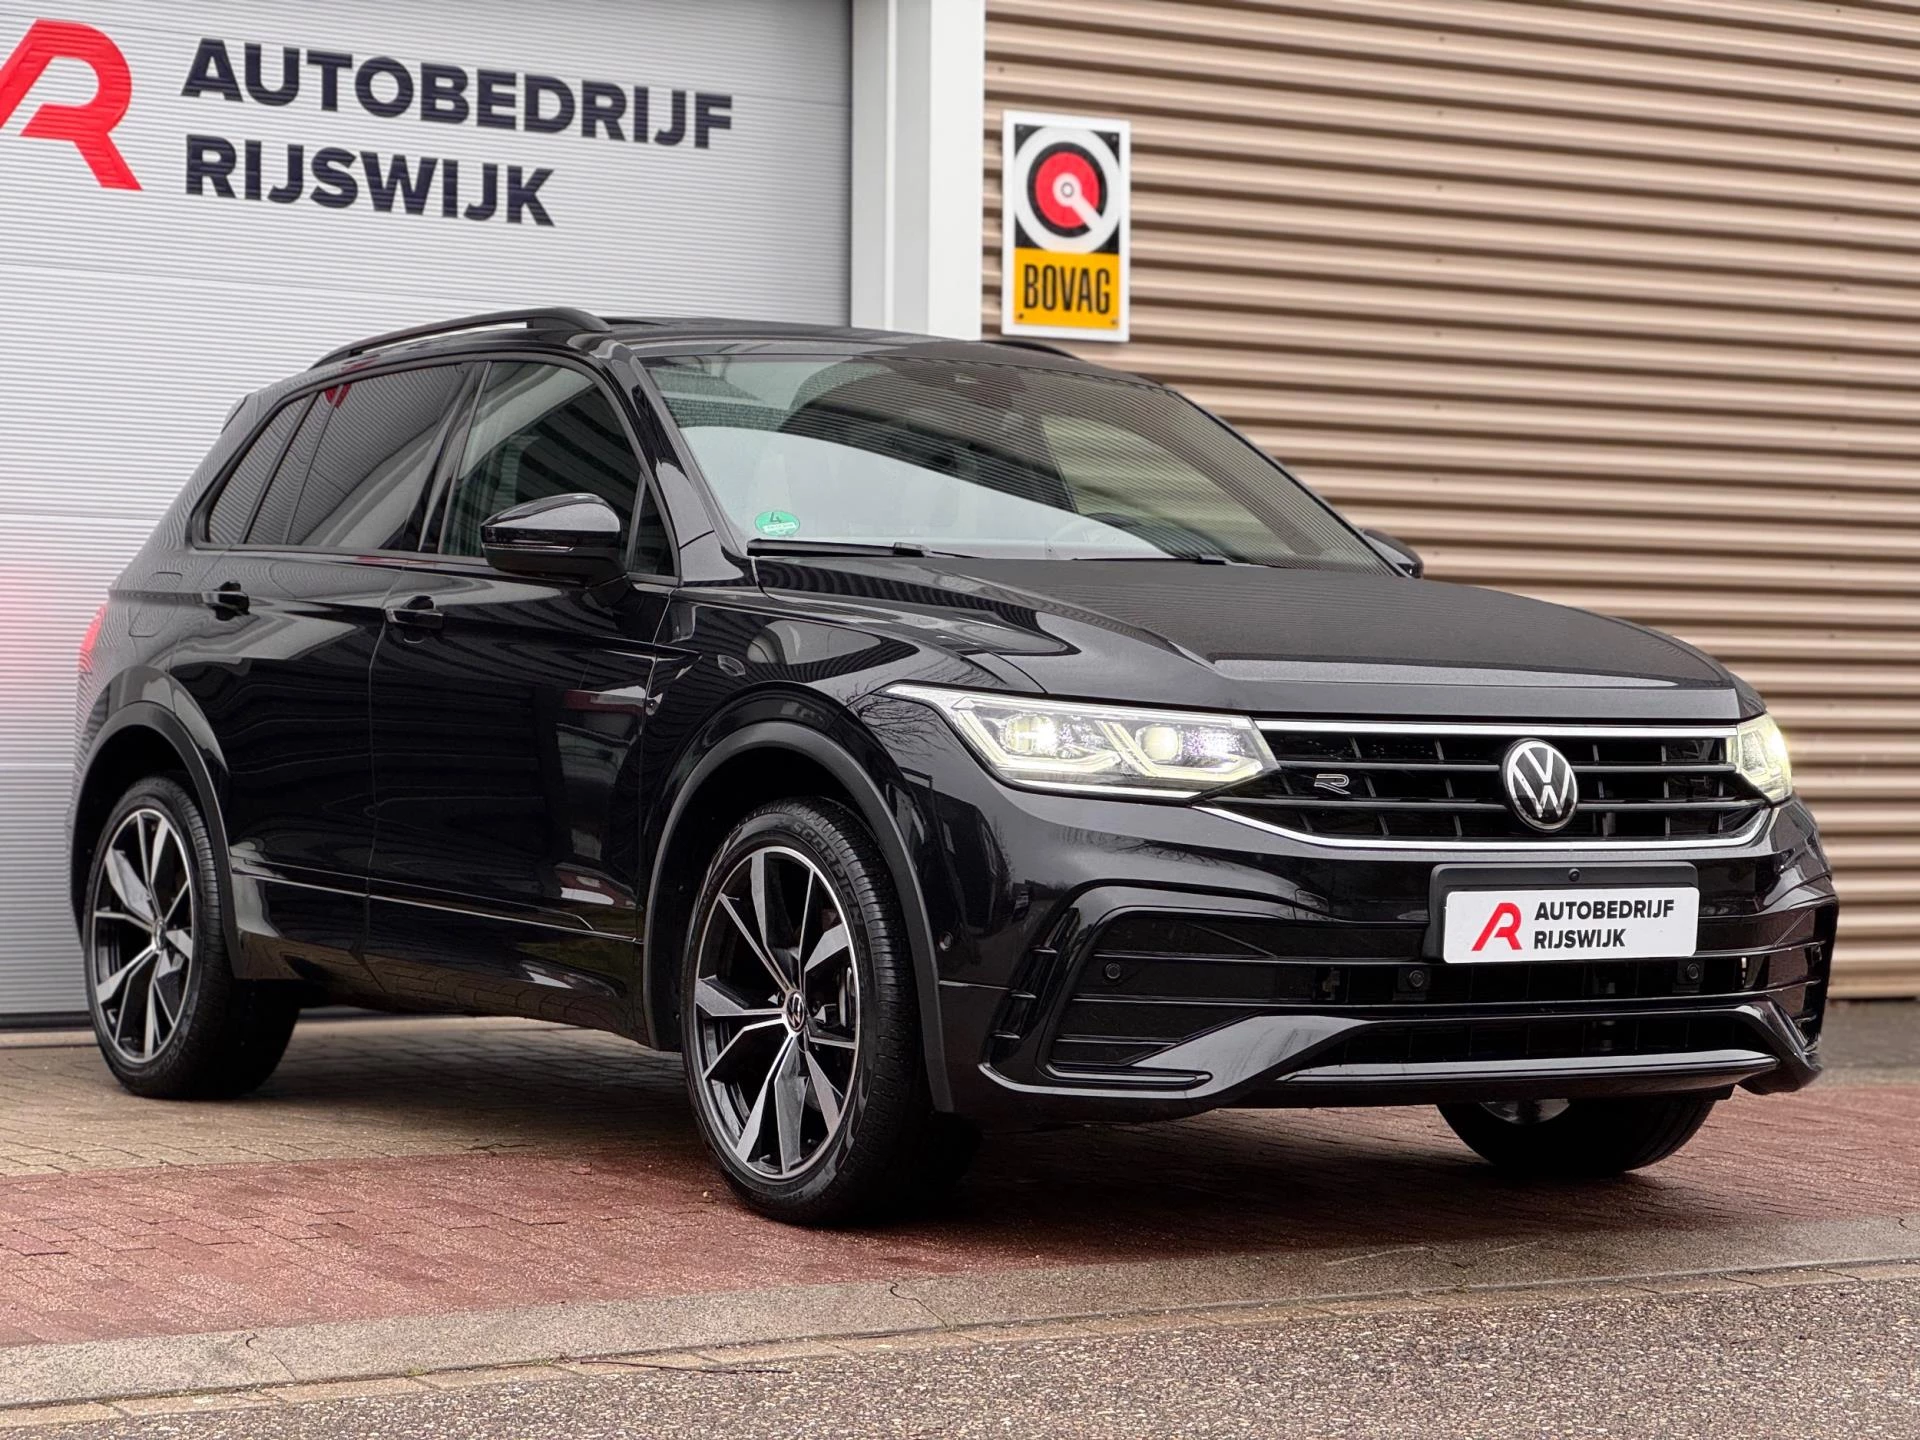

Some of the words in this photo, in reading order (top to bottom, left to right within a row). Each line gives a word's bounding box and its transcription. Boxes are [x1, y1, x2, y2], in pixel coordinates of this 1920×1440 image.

[181, 38, 732, 150] AUTOBEDRIJF
[186, 134, 555, 227] RIJSWIJK
[1023, 264, 1110, 314] BOVAG
[1535, 899, 1674, 921] AUTOBEDRIJF
[1534, 928, 1626, 949] RIJSWIJK
